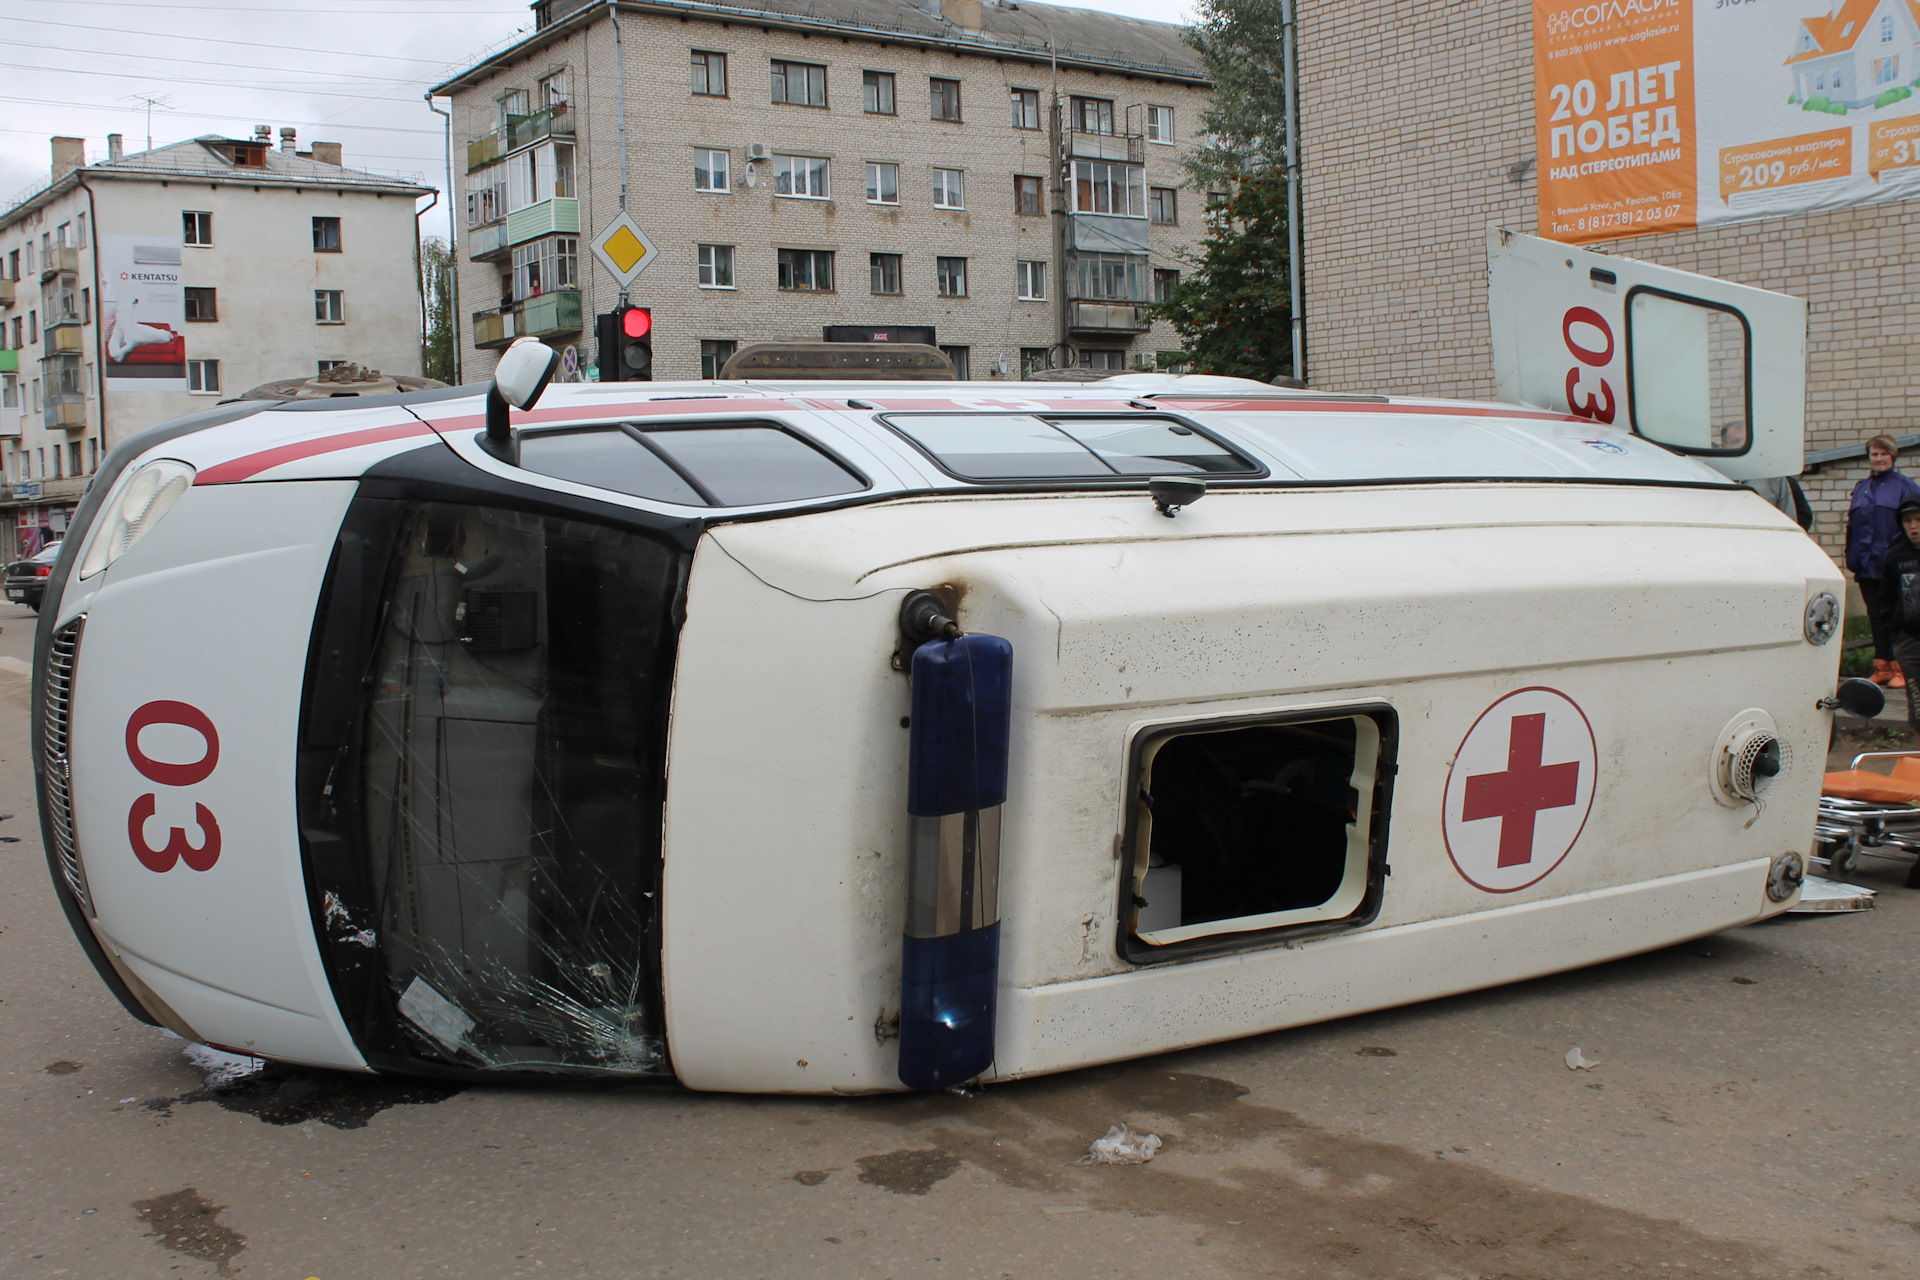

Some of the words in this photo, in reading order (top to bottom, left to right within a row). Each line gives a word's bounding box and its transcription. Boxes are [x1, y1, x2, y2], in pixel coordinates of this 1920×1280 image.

[1569, 45, 1583, 55] 200
[1605, 23, 1680, 46] www.soglasie.ru
[1549, 79, 1596, 122] 20
[1606, 60, 1681, 112] ЛЕТ
[1551, 105, 1681, 158] ПОБЕД
[1550, 165, 1579, 180] НАД
[1580, 147, 1681, 176] СТЕРЕОТИПАМИ
[1724, 146, 1792, 165] Страхование
[1794, 137, 1845, 153] квартиры
[1877, 148, 1889, 158] от
[1893, 137, 1920, 164] 31
[1724, 174, 1736, 184] от
[1739, 160, 1785, 188] 209
[1551, 221, 1576, 234] Тел.:
[1578, 218, 1585, 230] 8
[1588, 211, 1633, 231] (81738)
[1635, 209, 1643, 222] 2
[1646, 207, 1662, 220] 05
[1664, 204, 1680, 218] 07
[1557, 204, 1588, 216] Великий
[1613, 200, 1624, 210] ул.
[131, 273, 178, 281] KENTATSU
[1562, 306, 1616, 425] 03
[125, 699, 222, 873] 03
